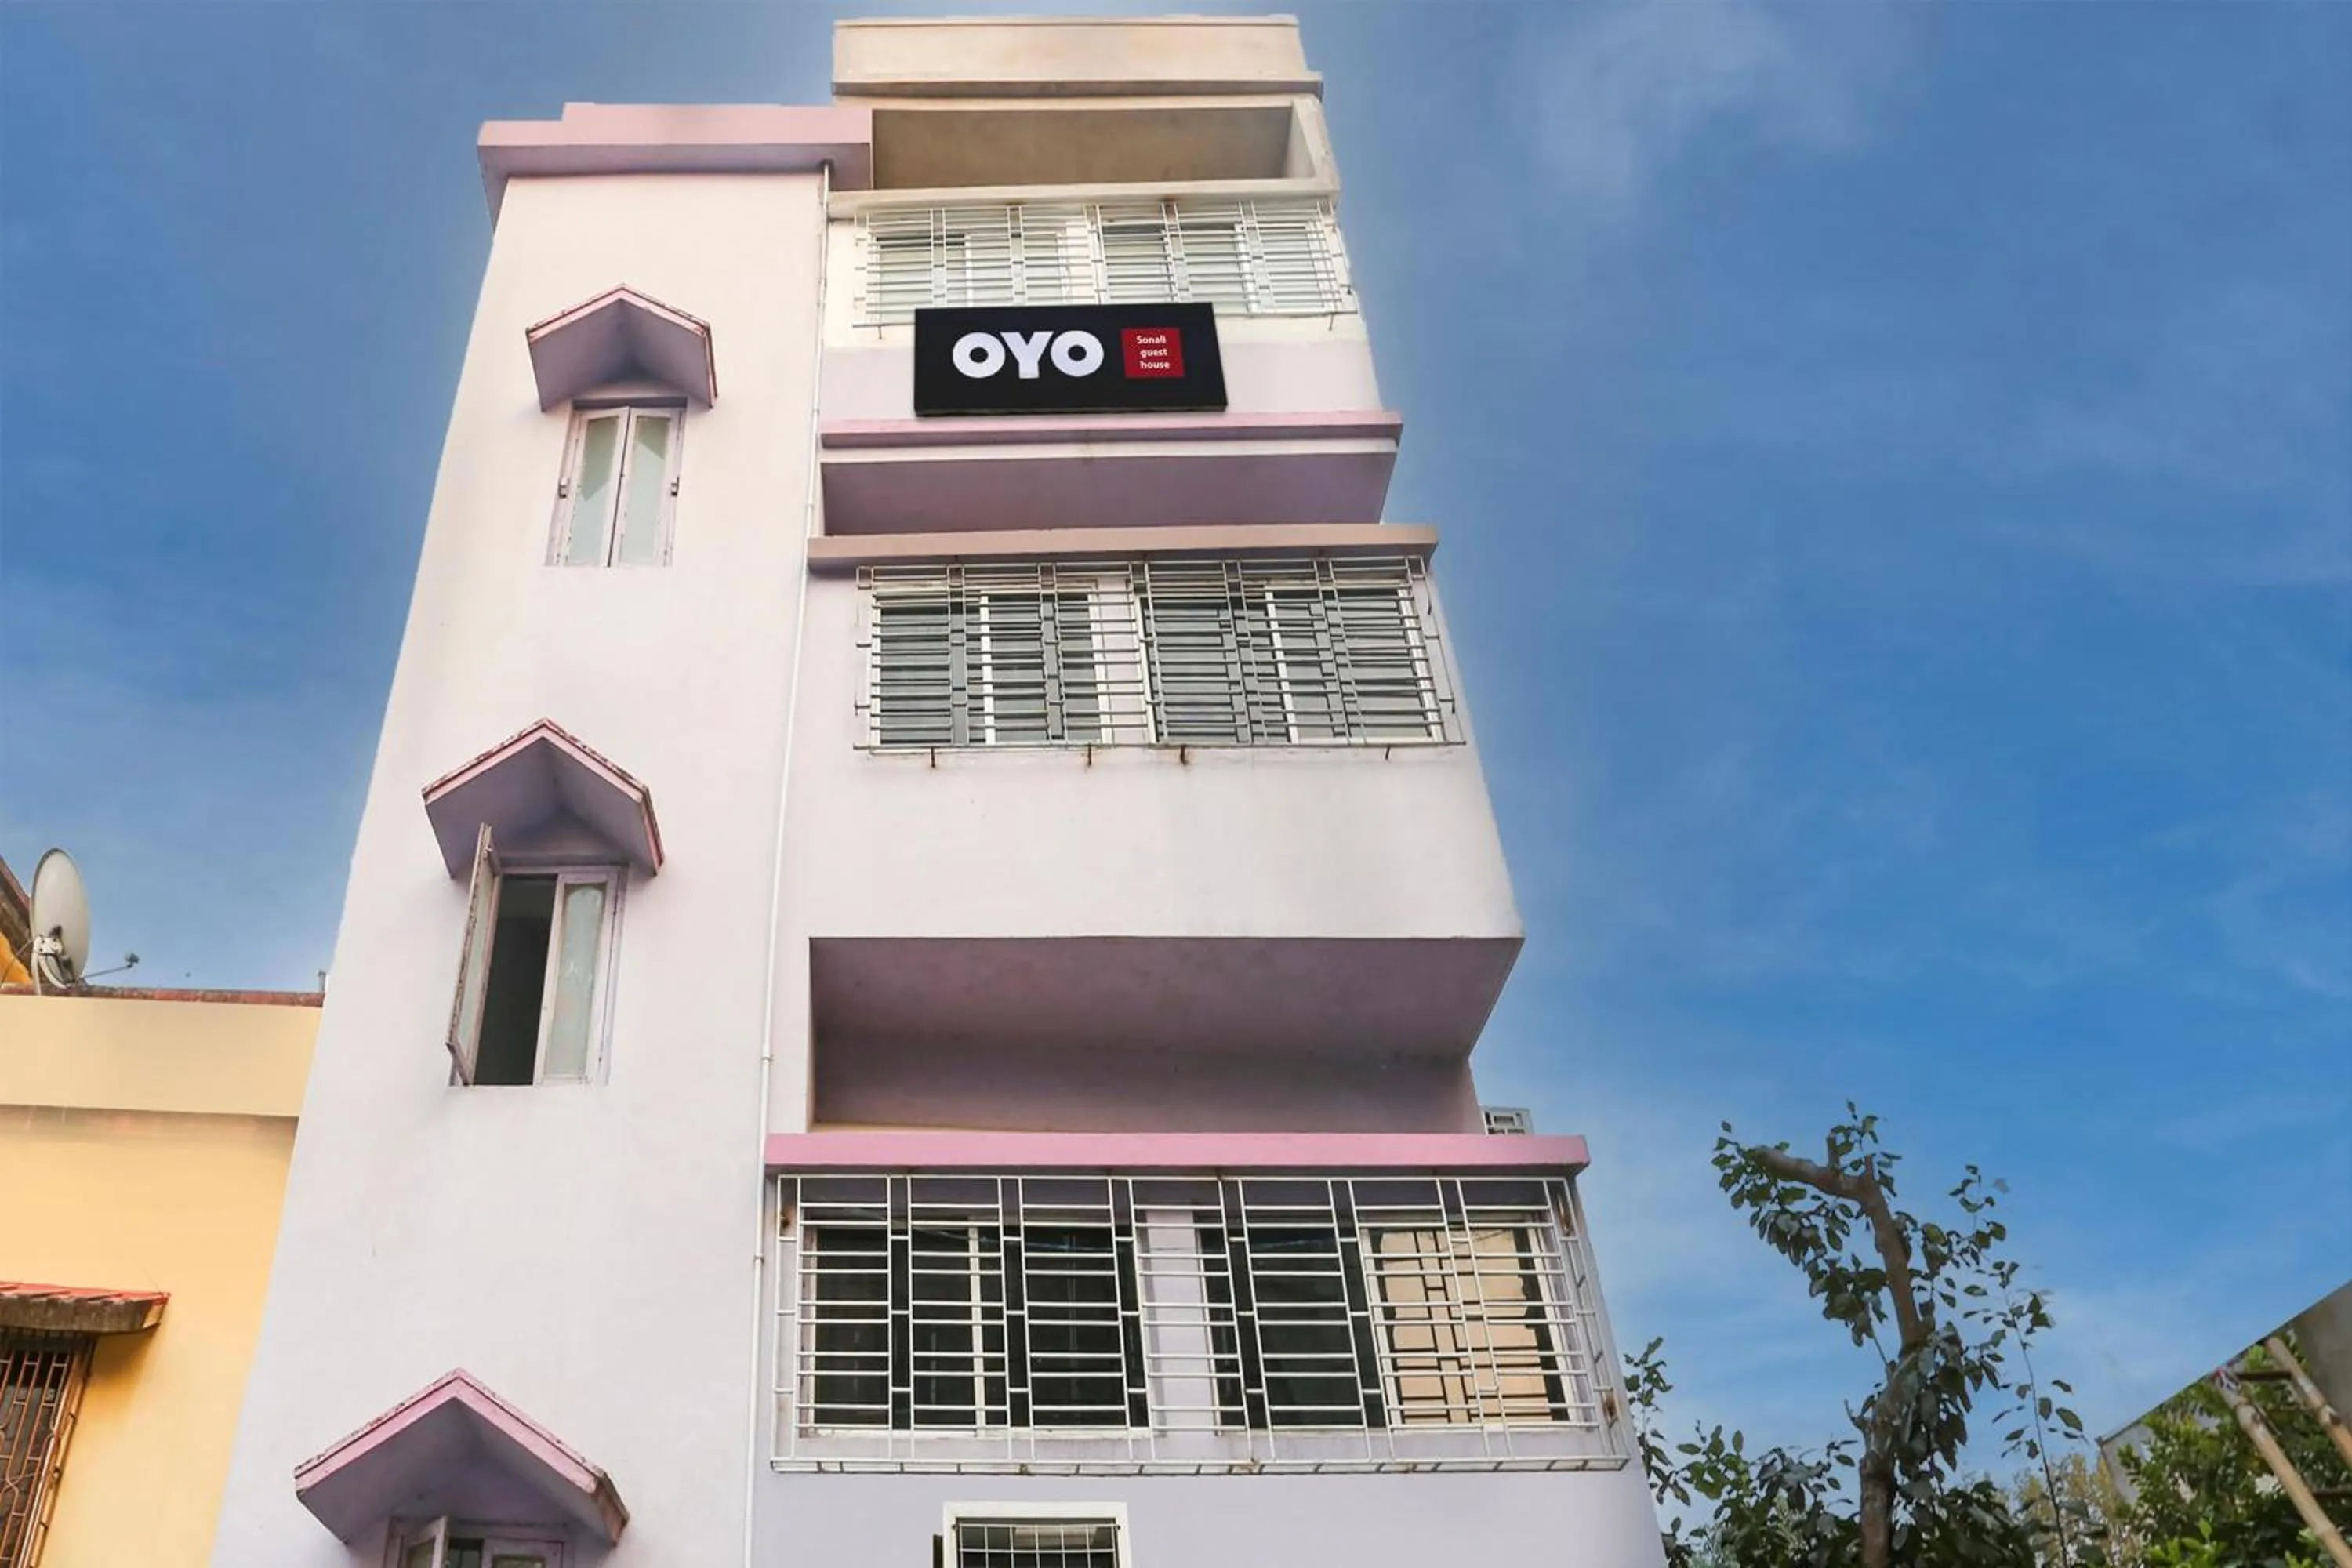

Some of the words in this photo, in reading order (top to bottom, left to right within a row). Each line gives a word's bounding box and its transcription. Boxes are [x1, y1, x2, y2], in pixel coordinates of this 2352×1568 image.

[1136, 335, 1167, 344] Sonali
[953, 330, 1105, 379] OYO
[1140, 348, 1167, 358] guest
[1140, 360, 1171, 369] house
